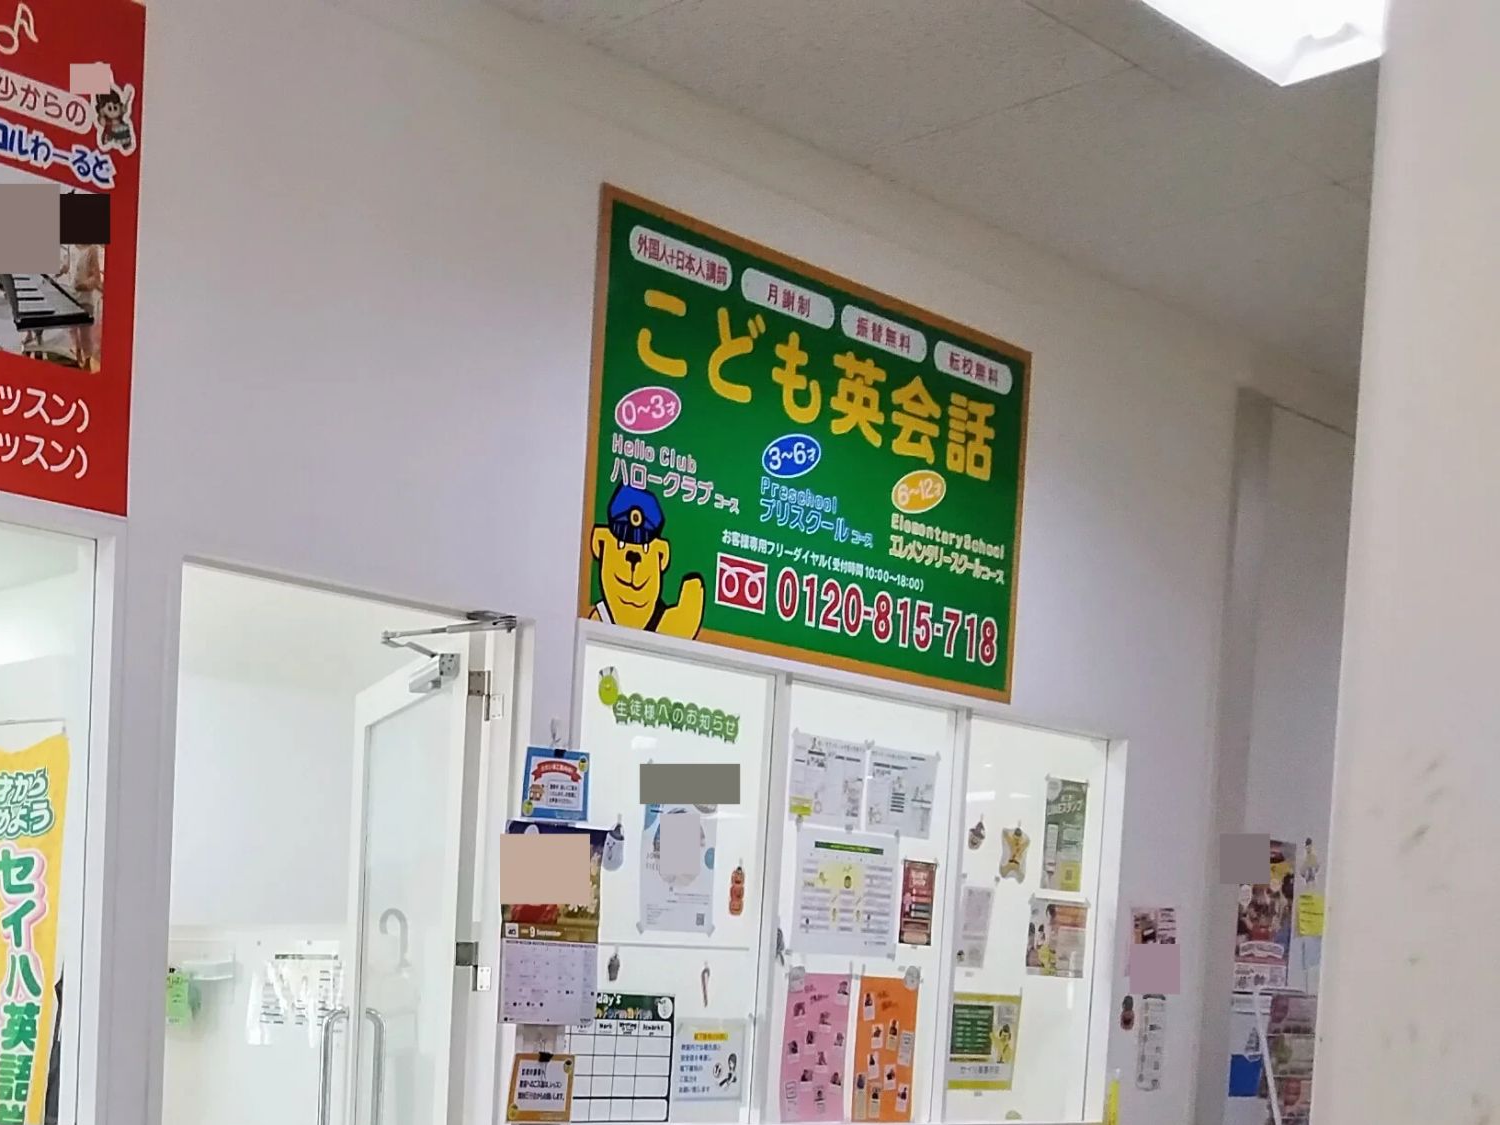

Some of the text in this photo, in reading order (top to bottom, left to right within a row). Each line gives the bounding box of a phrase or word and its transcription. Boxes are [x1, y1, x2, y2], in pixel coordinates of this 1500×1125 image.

[636, 289, 996, 482] こども英会話
[611, 433, 697, 474] Hello Club
[760, 476, 837, 515] Preschool
[776, 566, 998, 666] 0120-815-718
[615, 700, 738, 737] 生徒様へのお知らせ
[596, 992, 622, 1006] day's
